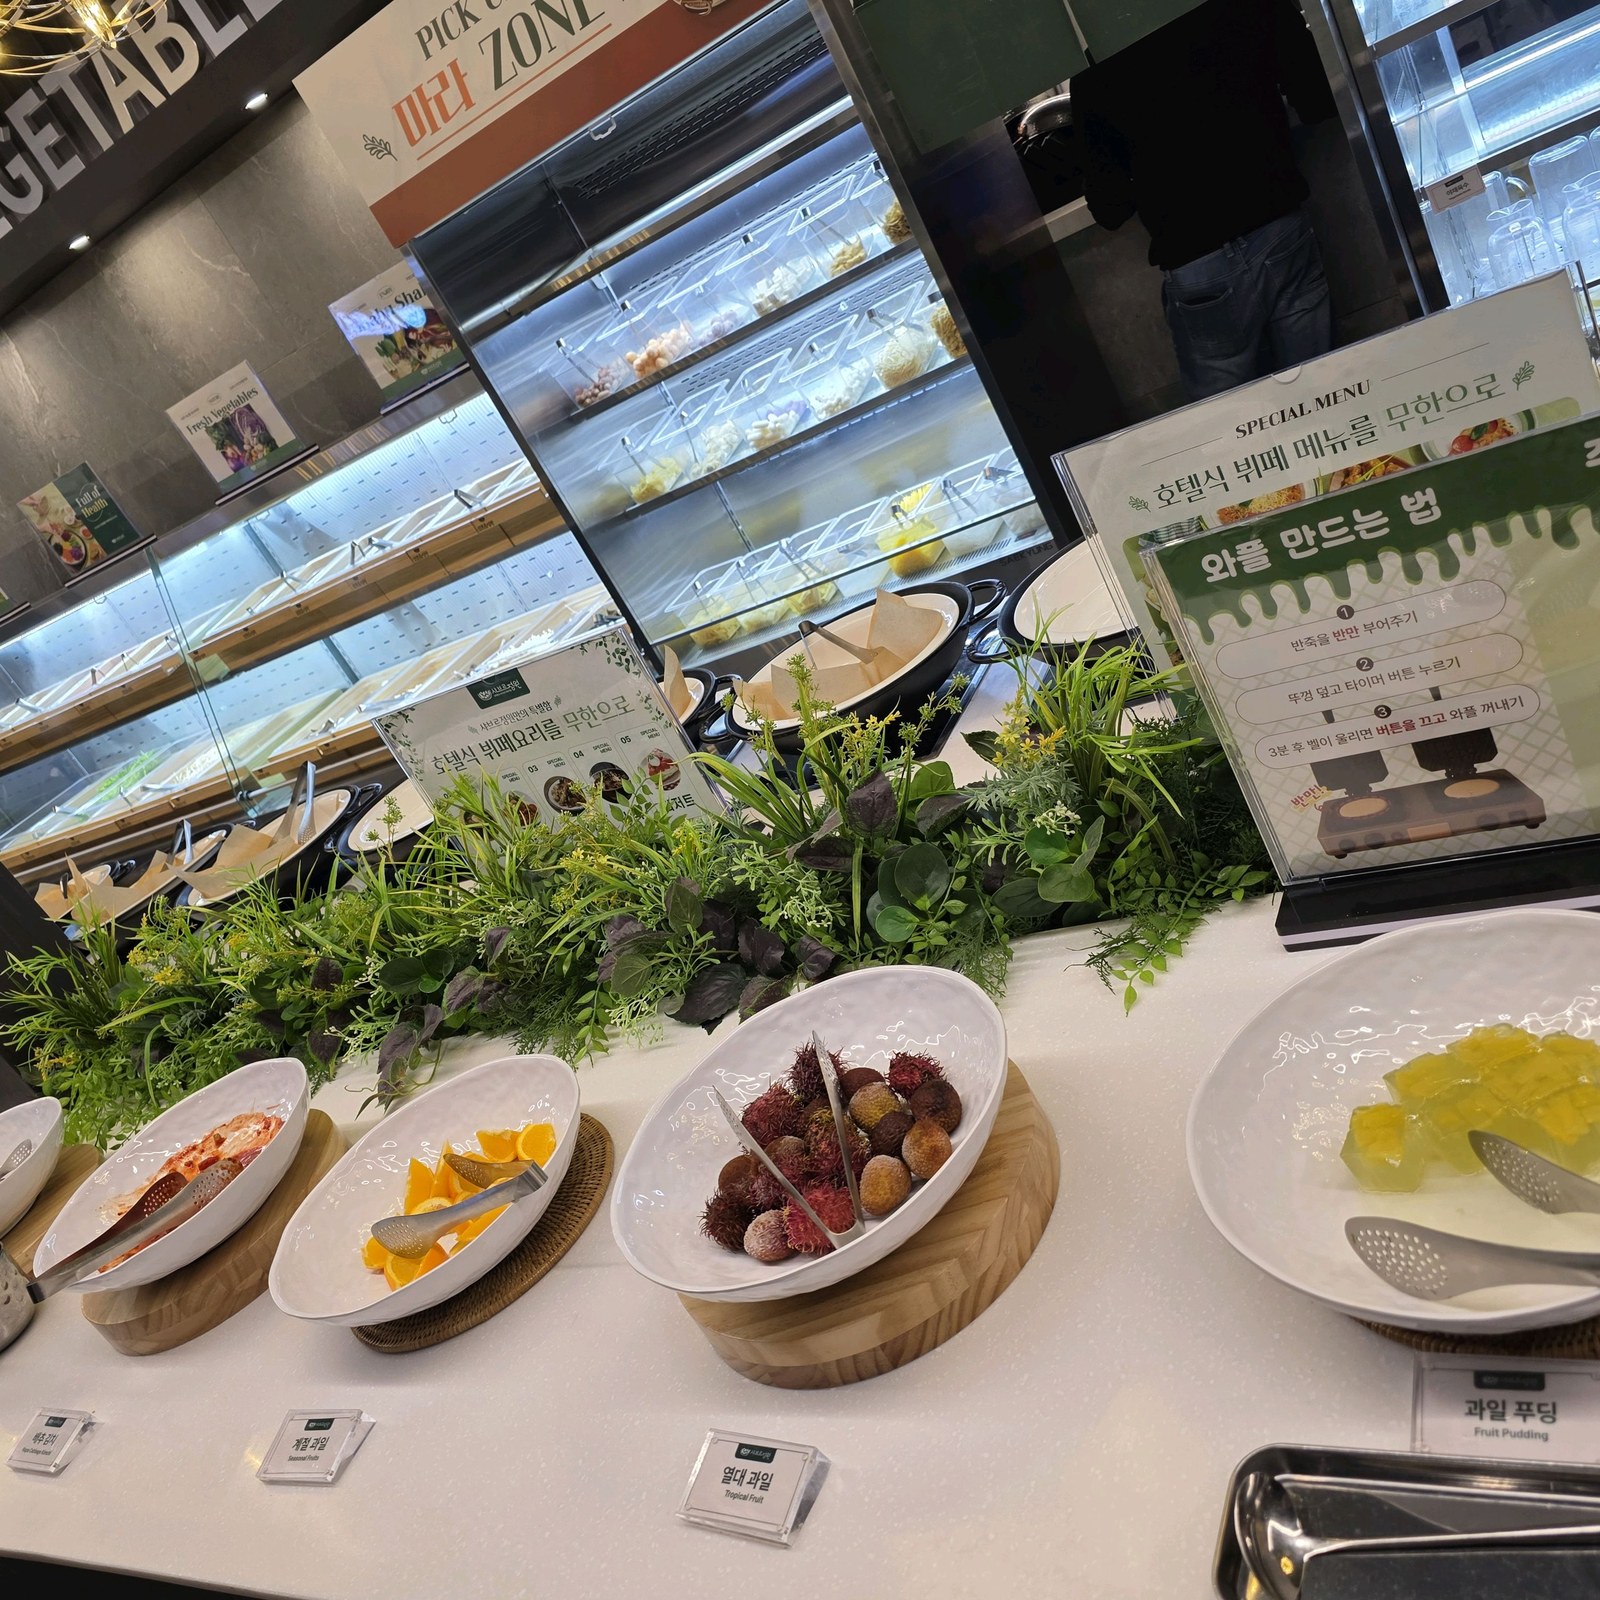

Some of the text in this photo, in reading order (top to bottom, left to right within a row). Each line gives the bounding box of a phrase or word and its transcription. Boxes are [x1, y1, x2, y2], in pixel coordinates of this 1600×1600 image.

[414, 0, 482, 61] PICK
[391, 58, 476, 148] 마라
[0, 0, 285, 240] GETABL
[186, 415, 213, 435] Fresh
[210, 387, 258, 417] Vegetables
[1235, 379, 1373, 440] SPECIAL MENU
[1153, 372, 1506, 510] 호텔식 뷔페 메뉴를 무한으로
[75, 485, 101, 507] Full of
[81, 498, 108, 518] Health
[1200, 487, 1442, 584] 와플 만드는 법
[1290, 610, 1418, 652] 반죽을 반만 부어주기
[1288, 655, 1461, 705] 뚜껑 덮고 타이머 버튼 누르기
[528, 701, 553, 715] 특별함
[431, 695, 635, 776] 호텔식 뷔페요리를 무한으로
[620, 735, 632, 745] 05
[1268, 695, 1525, 758] 3분 후 벨이 울리면 버튼을 끄고 와플 꺼내기
[573, 750, 585, 759] 04
[527, 766, 539, 774] 03
[1290, 784, 1324, 808] 반만!
[1464, 1398, 1557, 1425] 과일 푸딩
[292, 1436, 330, 1451] 계절 과일
[1474, 1427, 1549, 1442] Fruit Pudding
[721, 1466, 774, 1492] 열대 과일
[724, 1489, 764, 1504] Tropical Fruit
